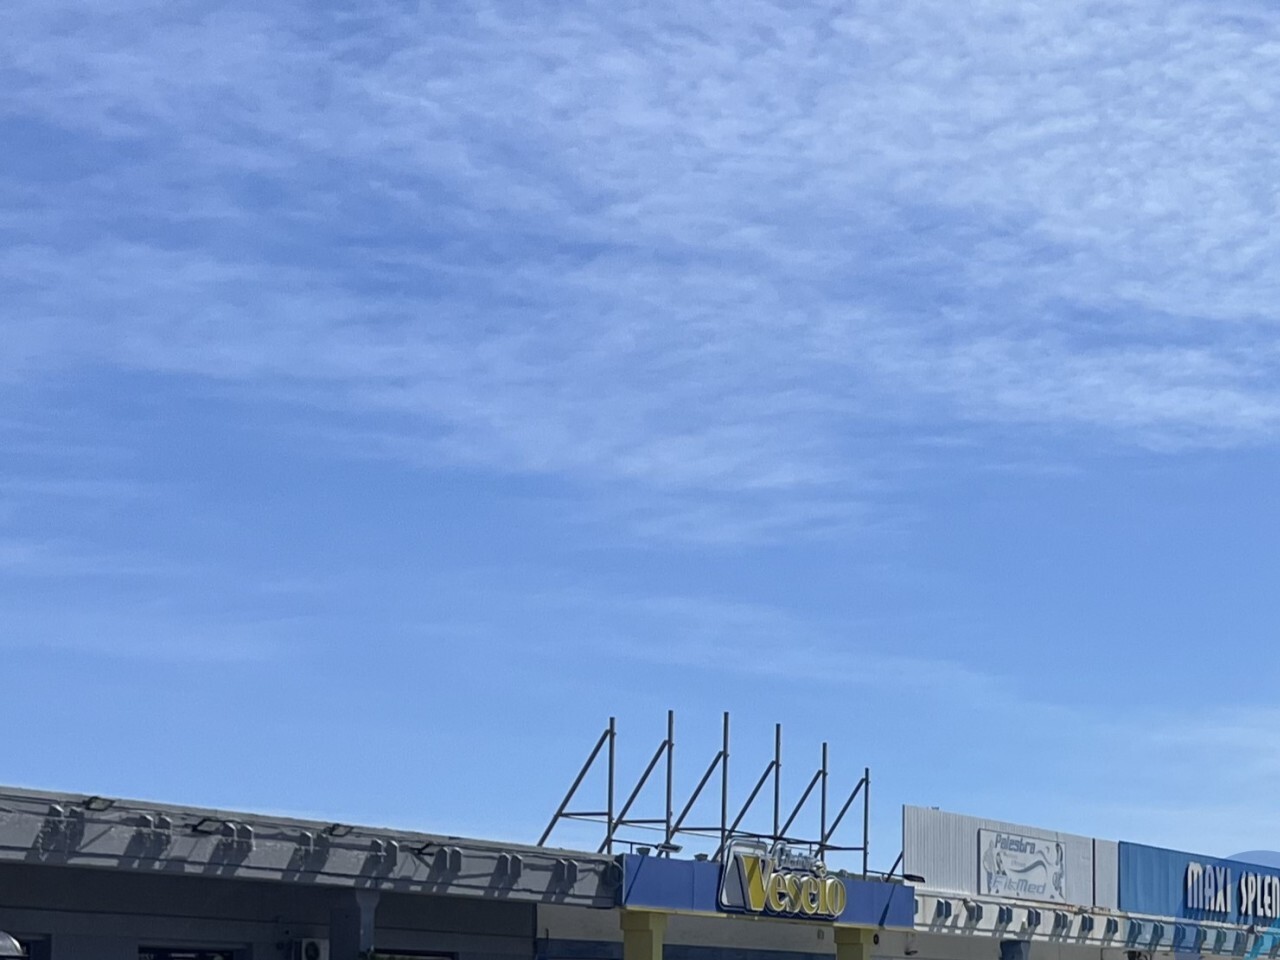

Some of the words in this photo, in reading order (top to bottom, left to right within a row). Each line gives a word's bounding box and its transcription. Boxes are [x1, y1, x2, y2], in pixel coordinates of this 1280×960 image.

[994, 834, 1036, 855] Palestra
[741, 853, 847, 916] Vescio
[1187, 862, 1232, 913] MAXI
